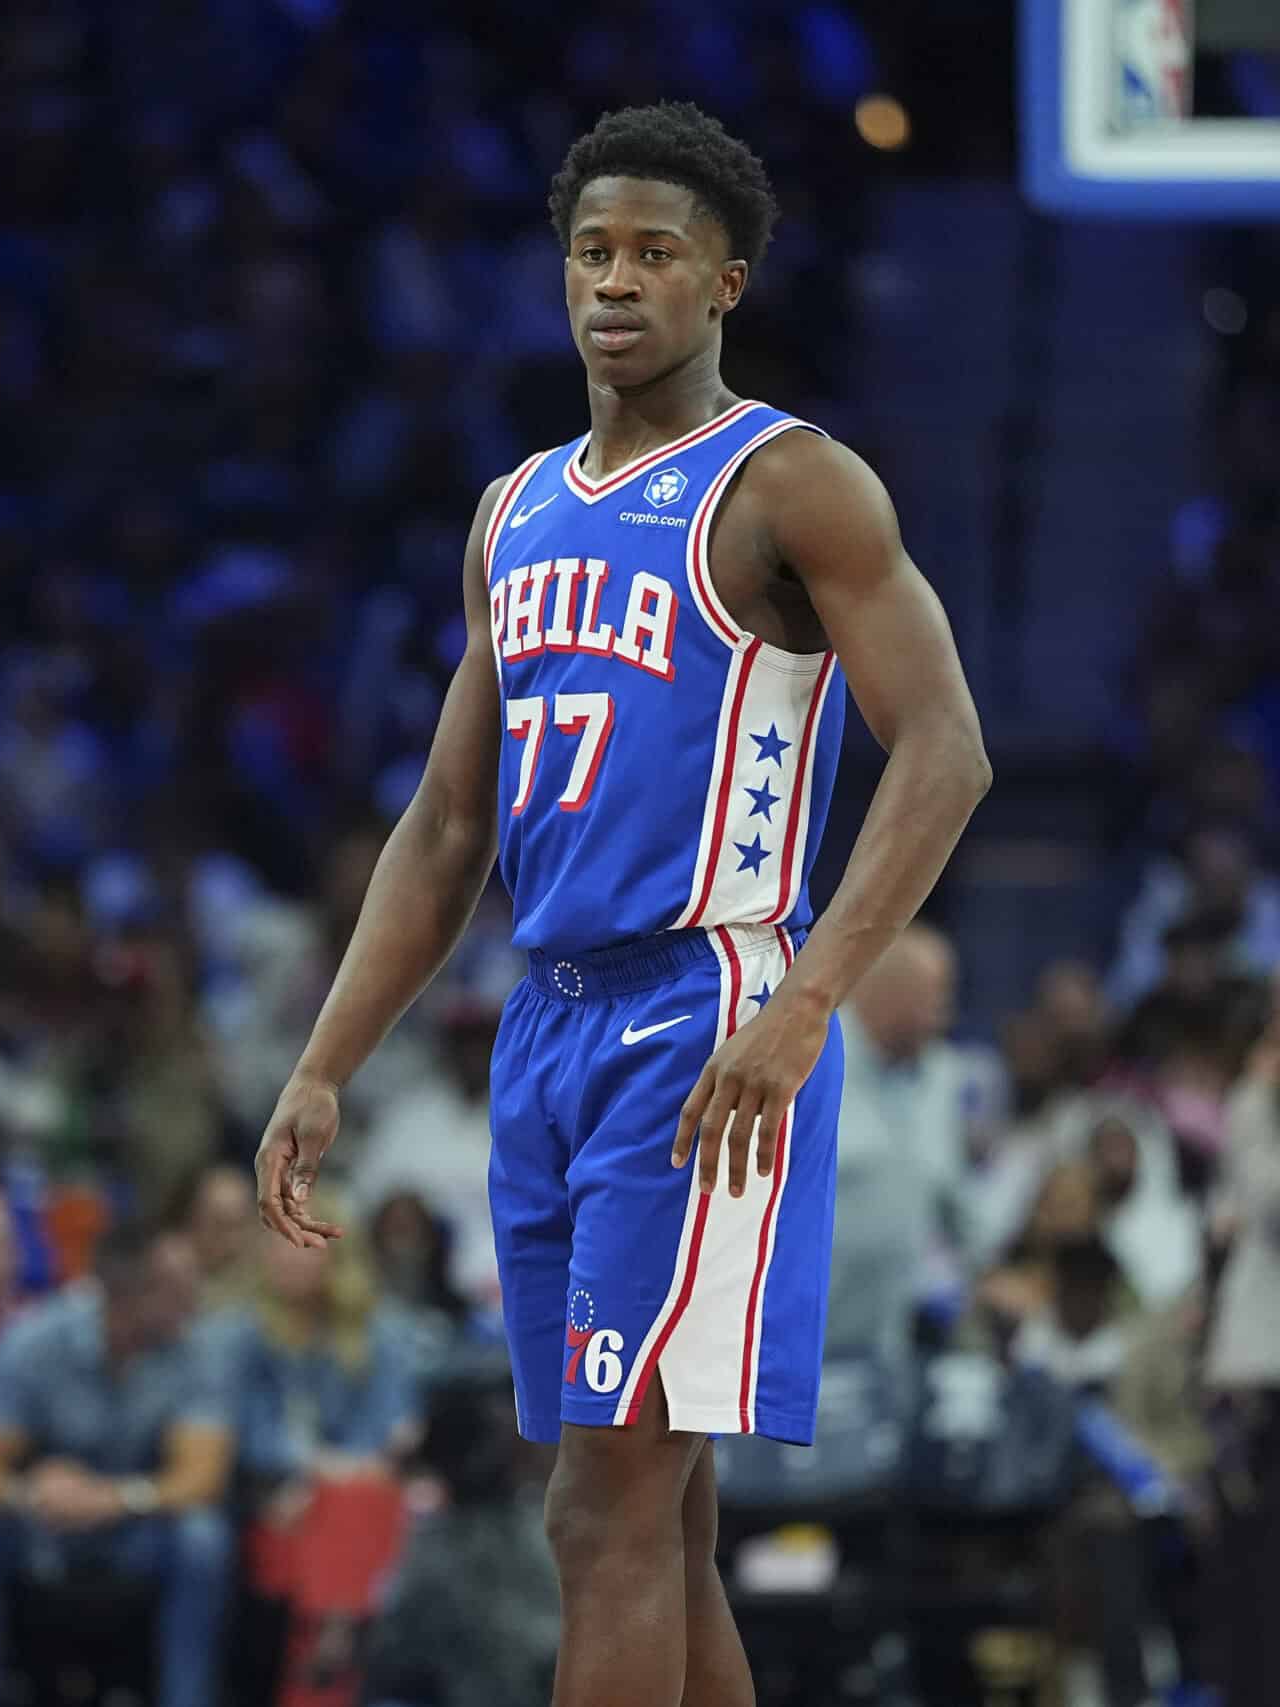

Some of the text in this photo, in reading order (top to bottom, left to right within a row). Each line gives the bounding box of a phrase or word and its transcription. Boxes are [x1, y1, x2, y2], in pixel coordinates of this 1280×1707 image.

[618, 511, 688, 530] crypto.com
[490, 557, 678, 682] PHILA
[506, 692, 614, 815] 77
[565, 1326, 624, 1393] 76
